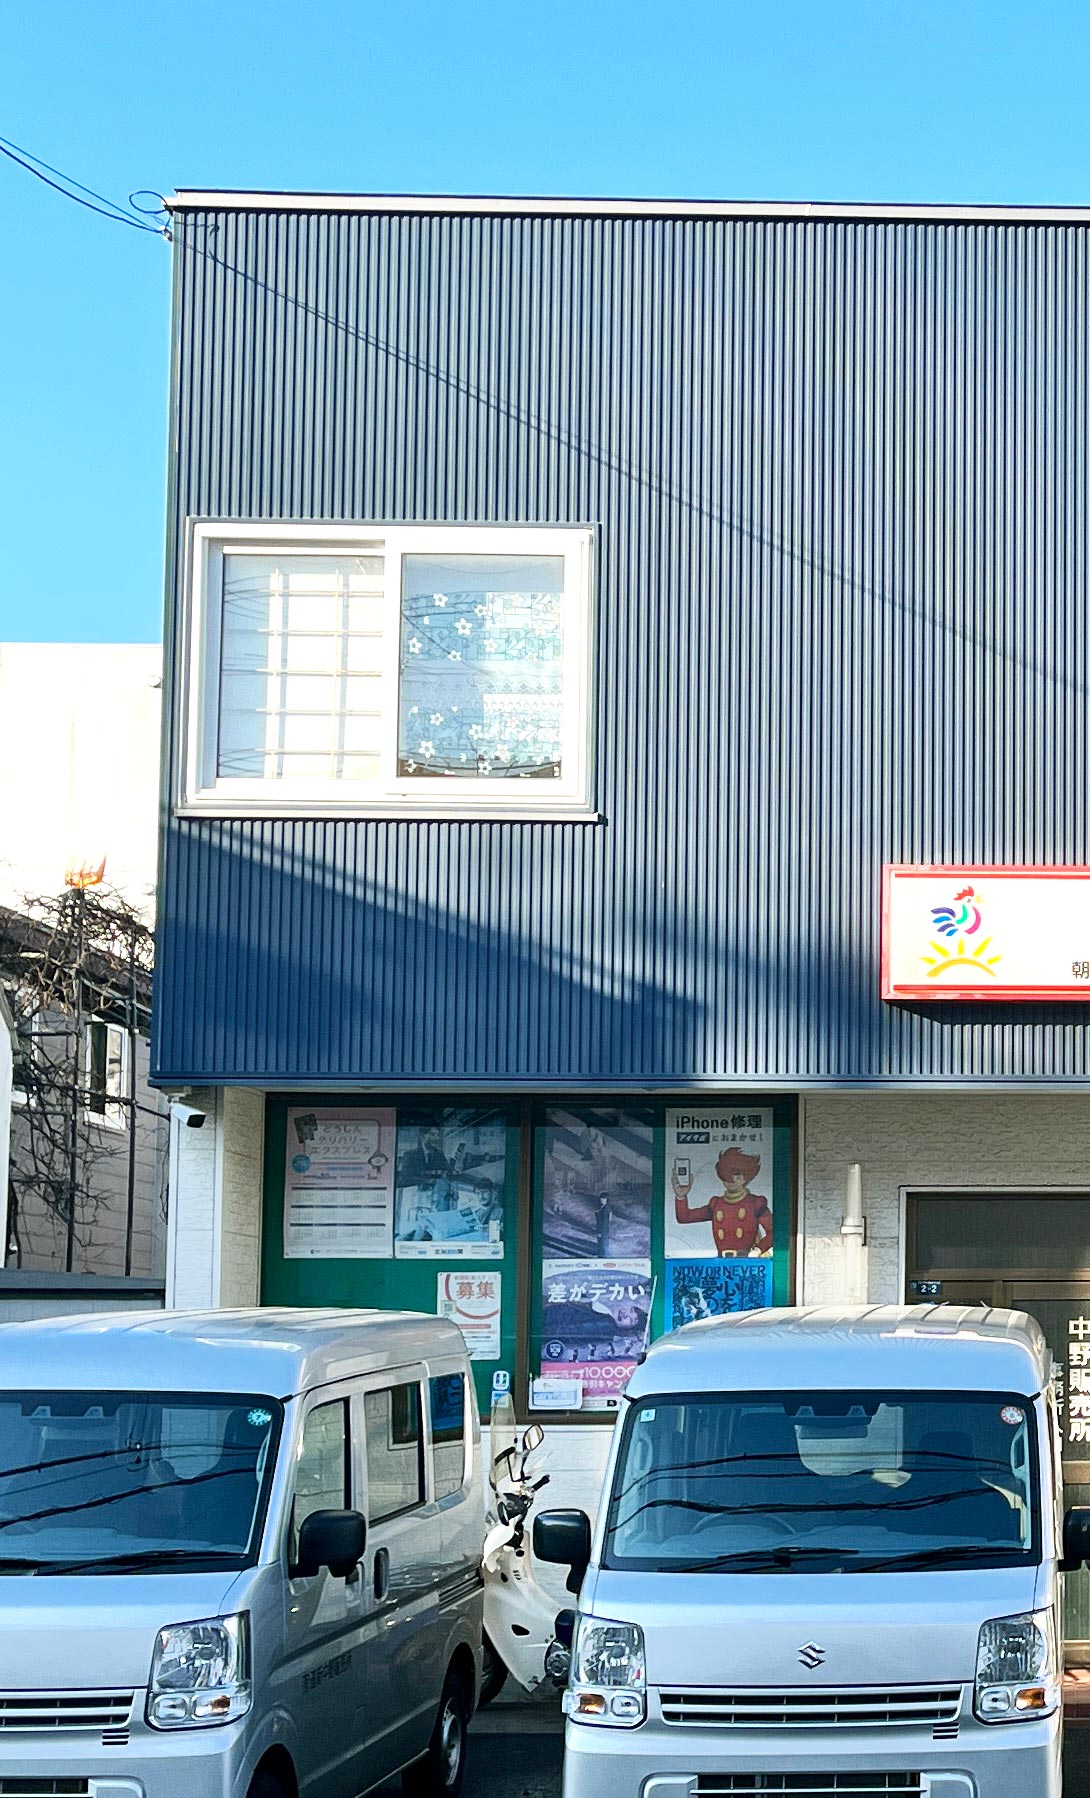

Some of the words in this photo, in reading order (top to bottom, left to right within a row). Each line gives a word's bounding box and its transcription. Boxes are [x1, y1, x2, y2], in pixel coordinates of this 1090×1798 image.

[676, 1114, 762, 1129] iPhone修理
[672, 1265, 704, 1277] NOW
[722, 1264, 766, 1277] NEVER
[456, 1281, 496, 1300] 募集
[548, 1282, 645, 1303] 差がデカい
